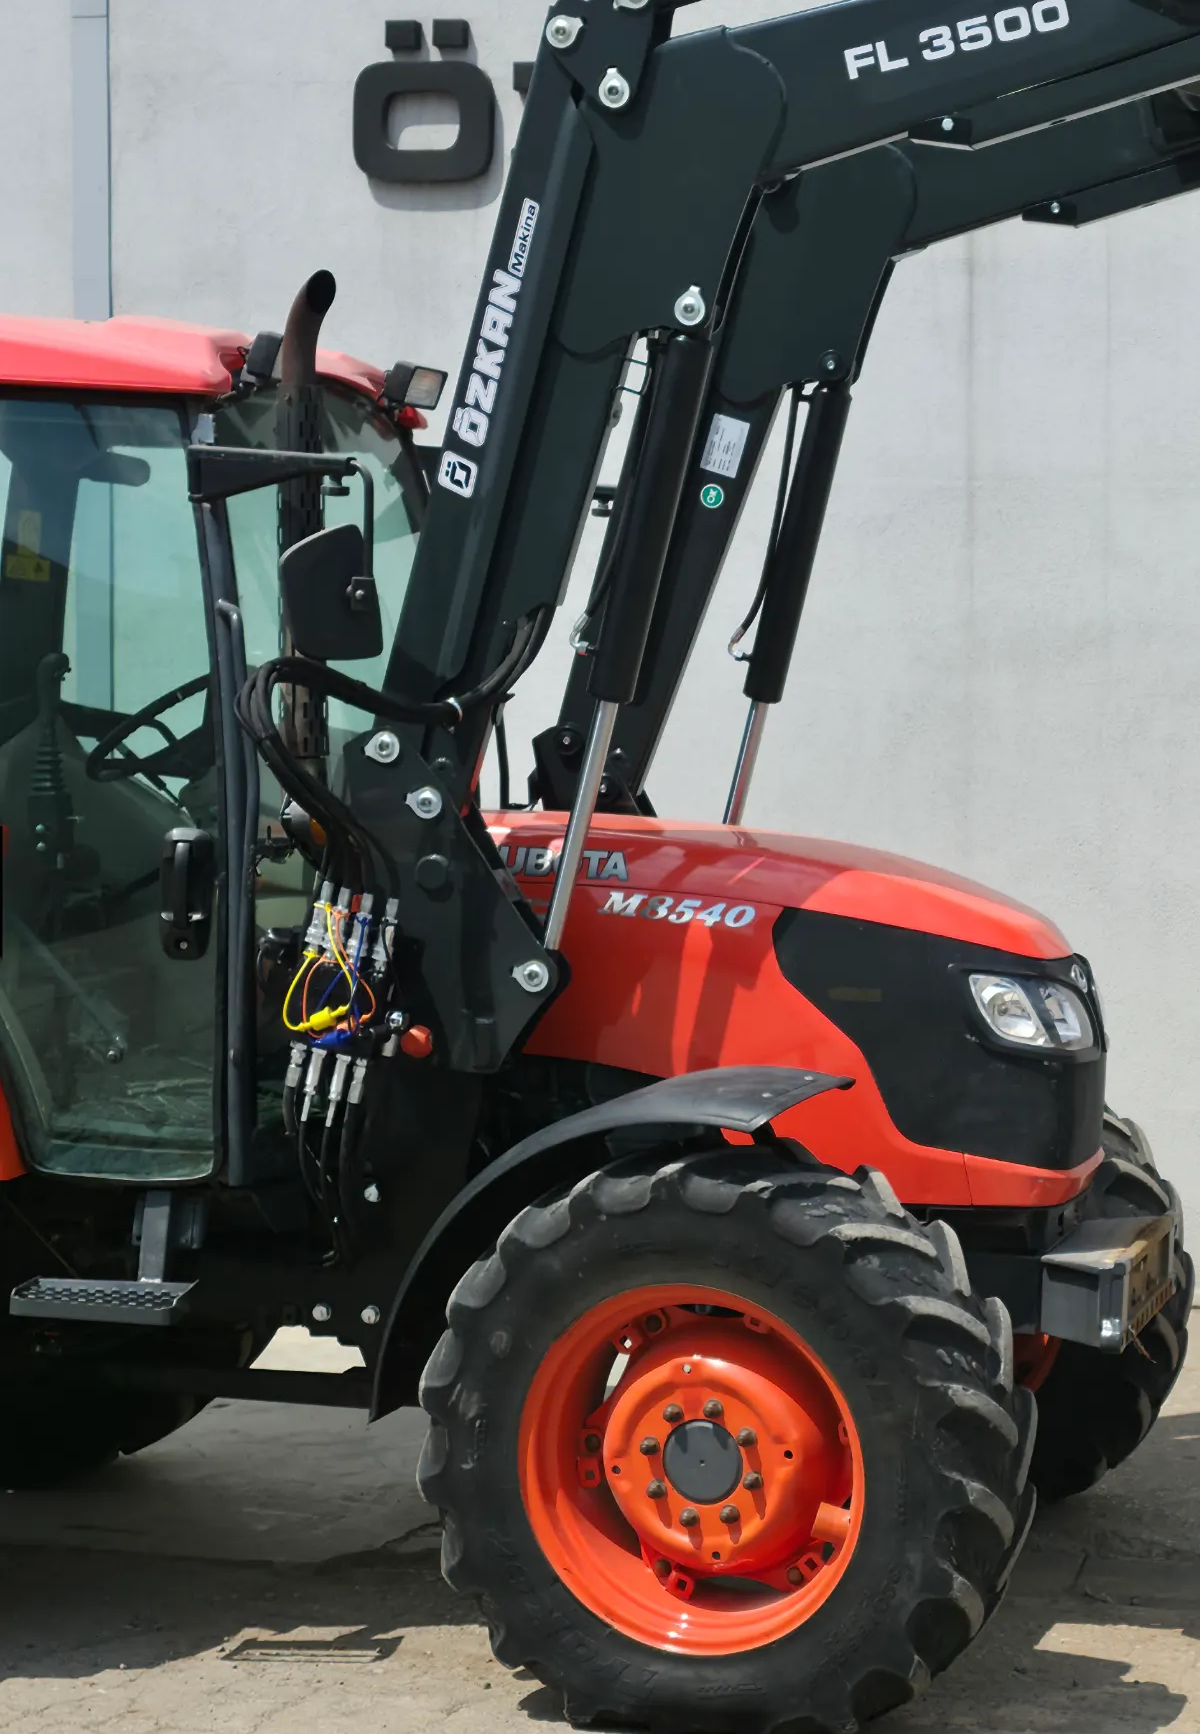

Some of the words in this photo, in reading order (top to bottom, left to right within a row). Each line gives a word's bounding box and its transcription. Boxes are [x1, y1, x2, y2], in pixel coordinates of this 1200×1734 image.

[843, 40, 909, 80] FL
[453, 269, 522, 447] ÖZKAN
[511, 203, 537, 274] Makina
[598, 891, 756, 927] M8540
